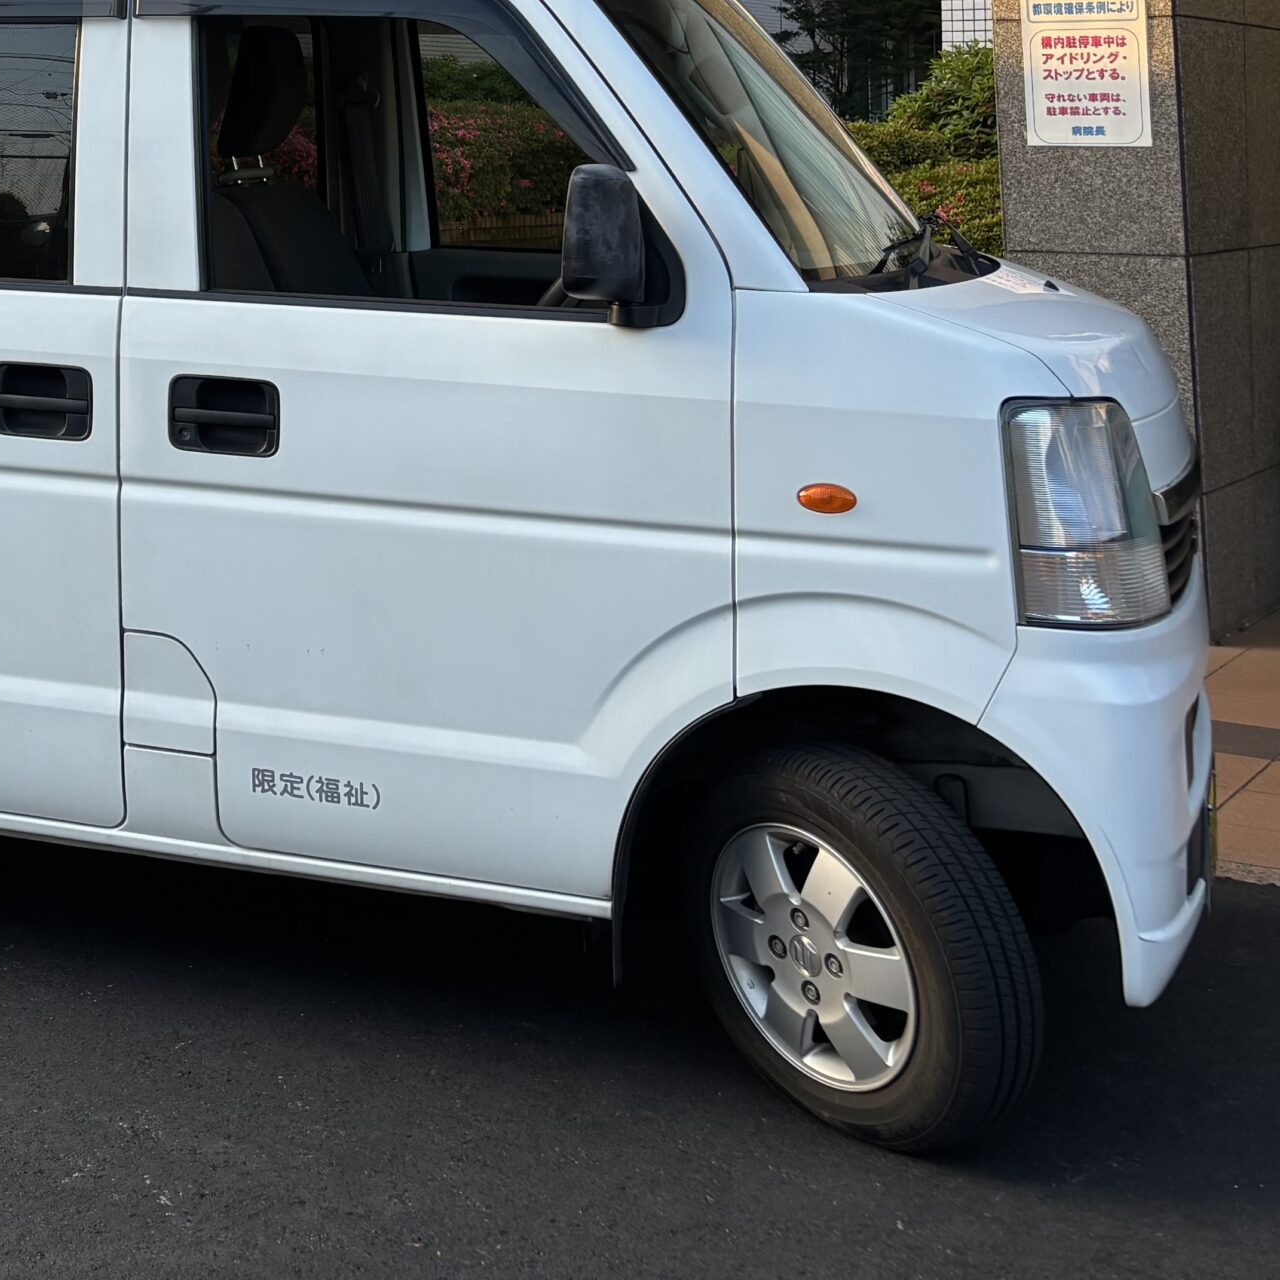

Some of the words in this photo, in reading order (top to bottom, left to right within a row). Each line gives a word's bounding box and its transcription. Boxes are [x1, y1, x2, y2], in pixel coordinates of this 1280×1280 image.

[1041, 35, 1127, 49] 構内駐停車中は
[1042, 68, 1126, 81] ストップとする。
[1045, 92, 1127, 103] 守れない車両は、
[1046, 106, 1127, 116] 駐車禁止とする。
[1071, 126, 1106, 136] 病院長
[251, 767, 381, 810] 限定(福祉)
